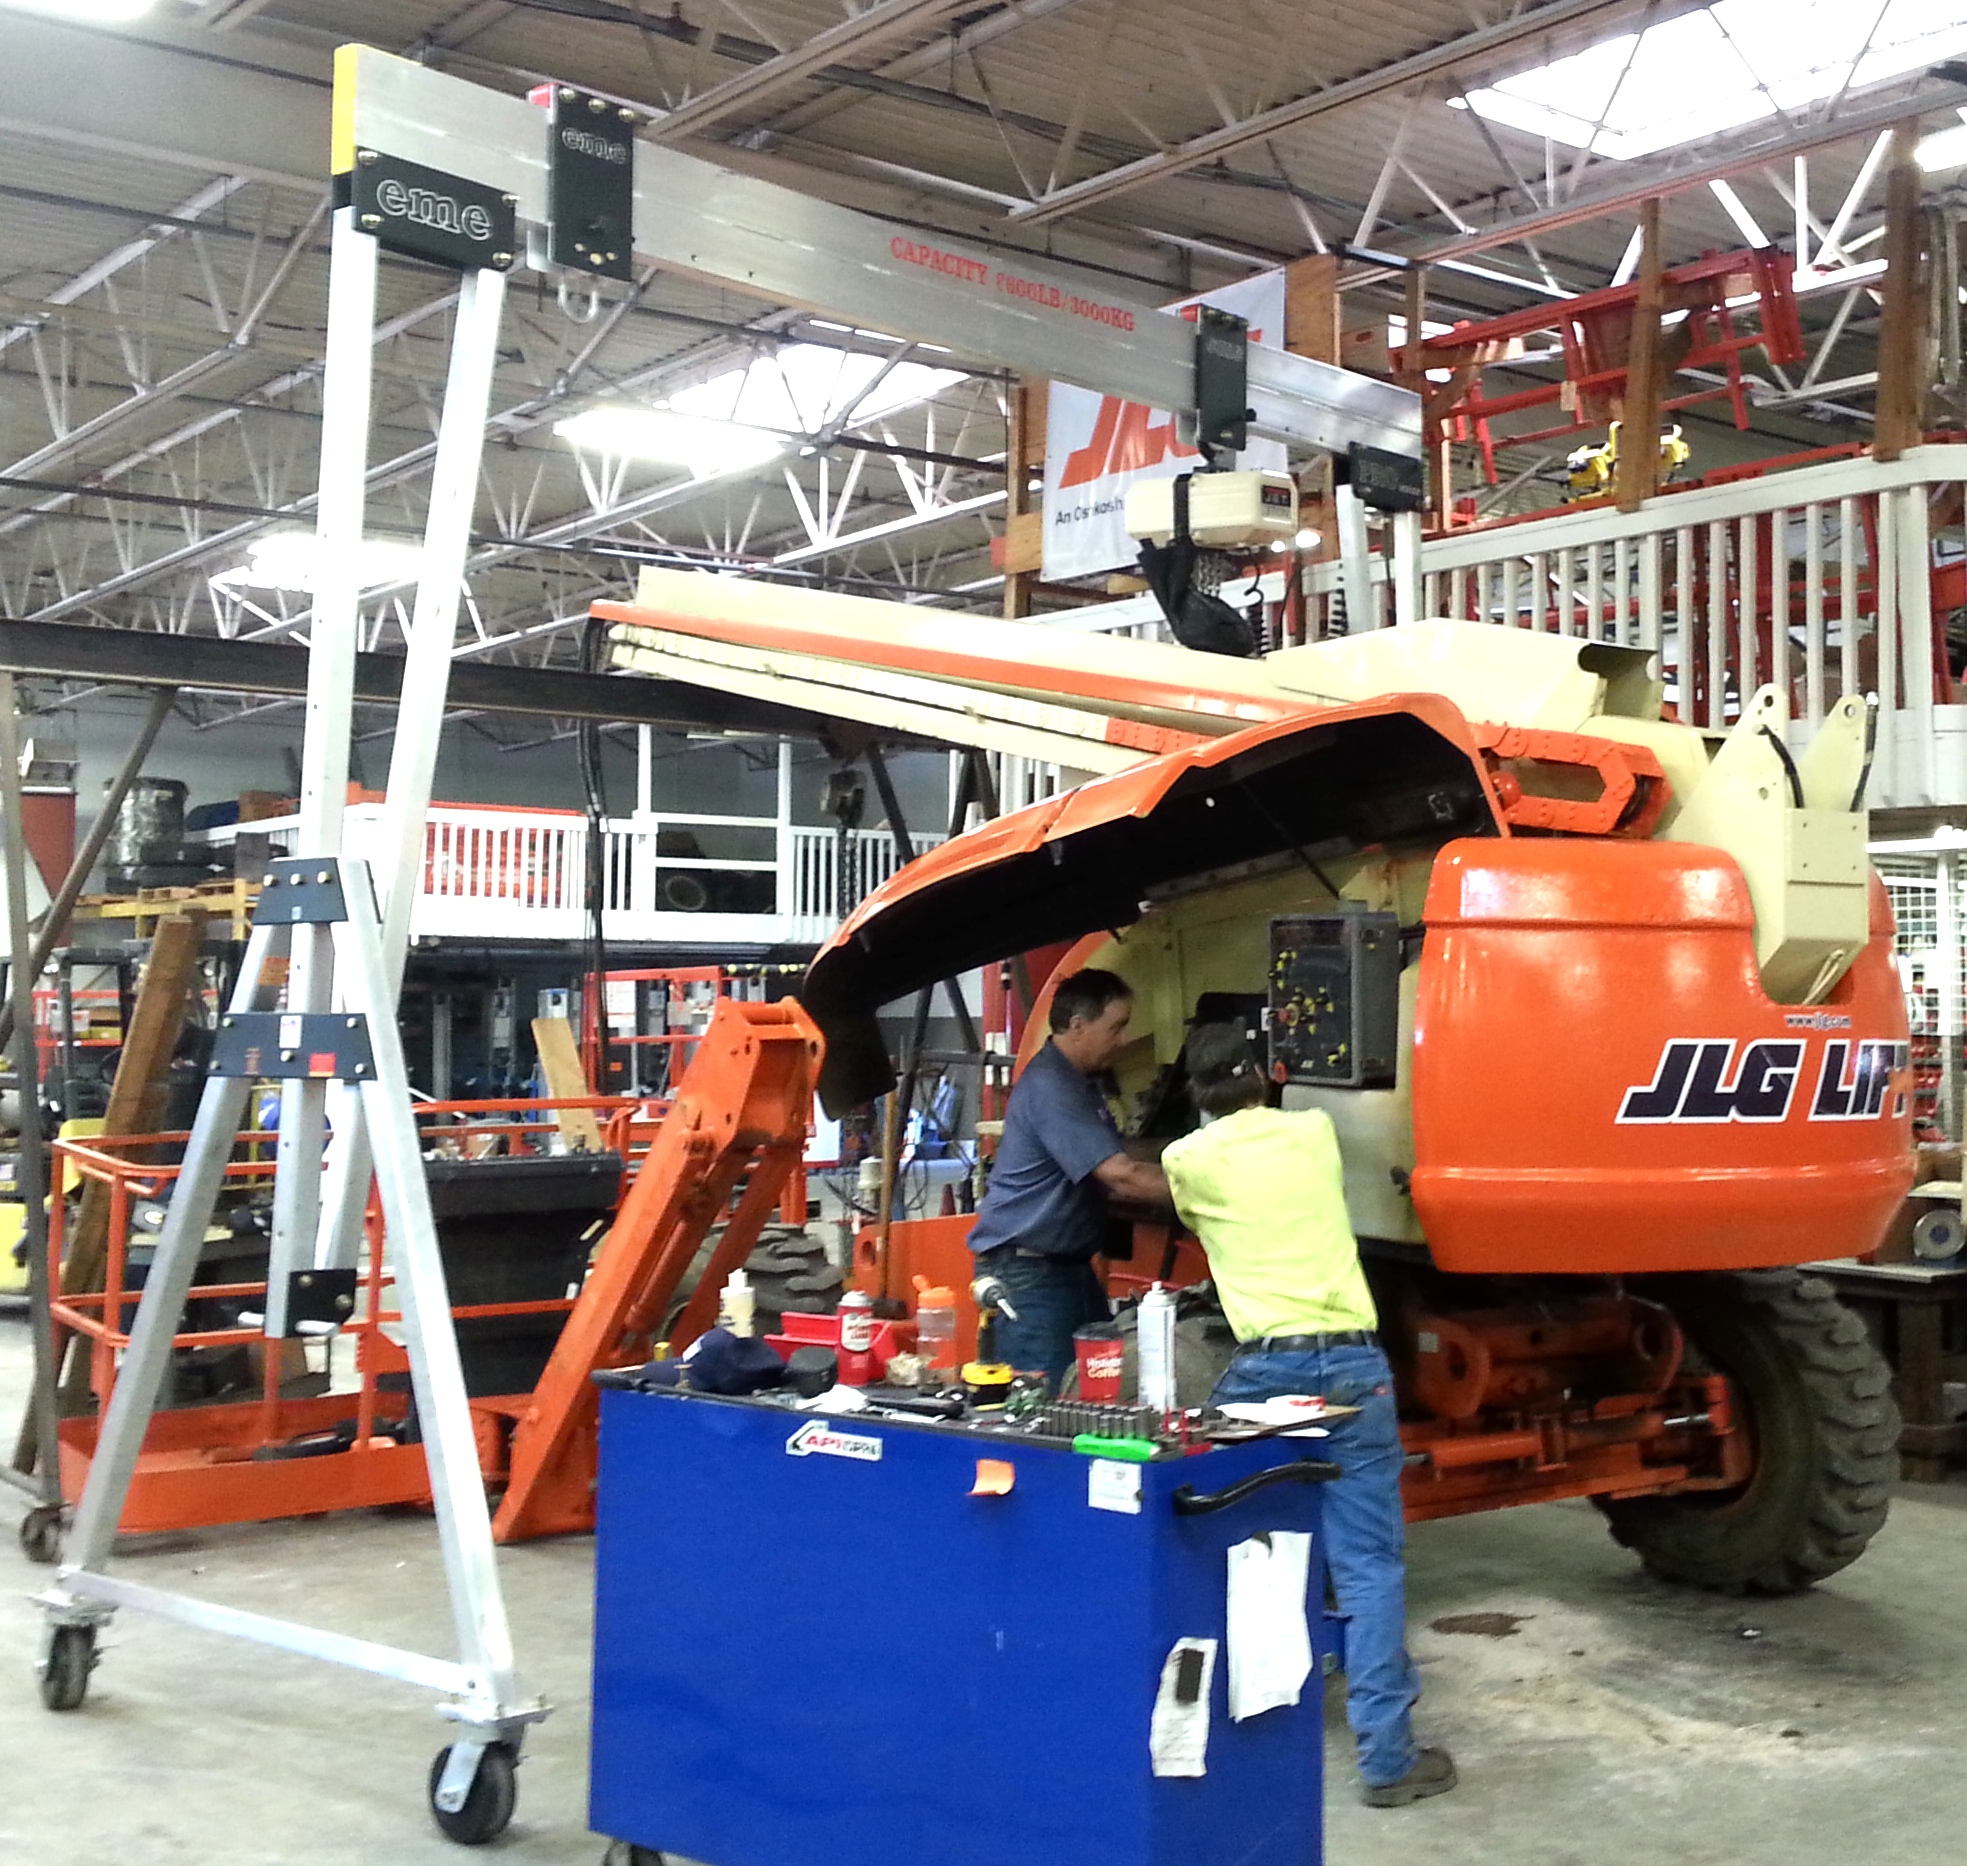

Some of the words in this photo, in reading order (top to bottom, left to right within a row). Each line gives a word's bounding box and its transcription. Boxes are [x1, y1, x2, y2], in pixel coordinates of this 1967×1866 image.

[562, 127, 627, 165] eme
[376, 178, 492, 241] eme
[890, 236, 989, 286] CAPACITY
[1055, 510, 1071, 526] An
[1074, 497, 1125, 522] Oskosh
[1614, 1038, 1807, 1124] JLG
